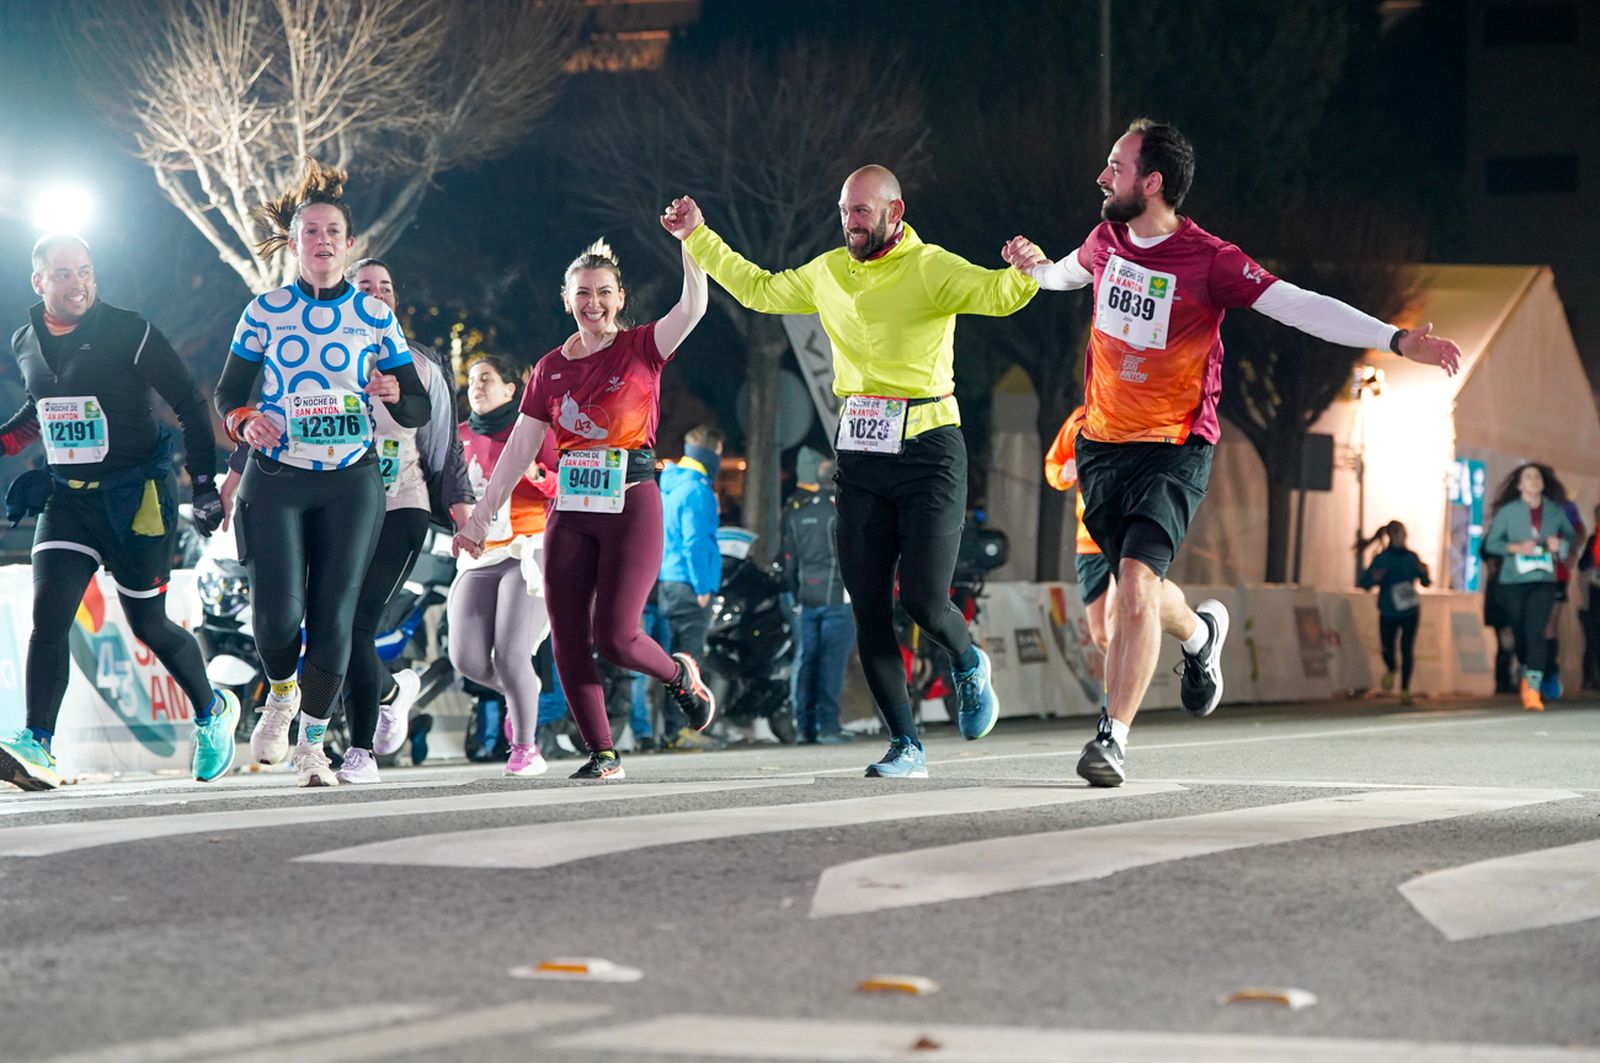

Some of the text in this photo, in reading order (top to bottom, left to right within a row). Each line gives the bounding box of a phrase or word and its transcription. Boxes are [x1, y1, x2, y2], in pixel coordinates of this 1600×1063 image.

[1108, 286, 1155, 321] 6839
[303, 398, 327, 407] NOCHE
[294, 408, 311, 418] SAN
[48, 420, 95, 441] 12191
[299, 415, 360, 438] 12376
[564, 459, 577, 467] SAN
[572, 451, 591, 459] NOCHE
[378, 458, 394, 477] 2
[569, 468, 610, 490] 9401
